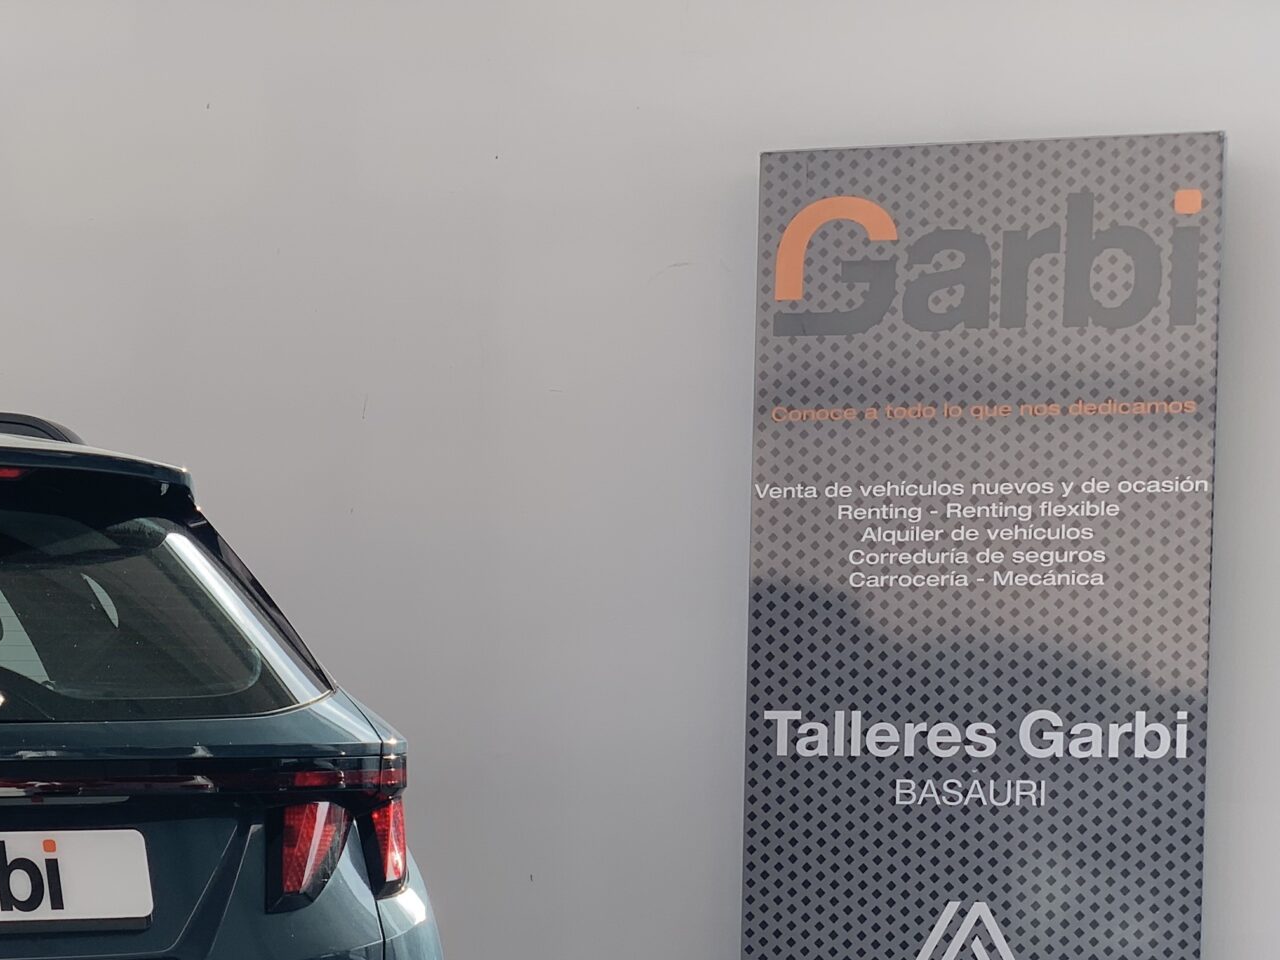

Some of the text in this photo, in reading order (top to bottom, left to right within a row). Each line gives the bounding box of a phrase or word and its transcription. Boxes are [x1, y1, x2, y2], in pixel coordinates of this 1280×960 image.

[773, 188, 1202, 337] Garbi
[771, 399, 1198, 422] Conoce a todo lo que nos dedicamos
[755, 476, 1208, 498] Venta de vehículos nuevos y de ocasión
[837, 504, 922, 522] Renting
[946, 502, 1032, 521] Renting
[1039, 501, 1120, 517] flexible
[860, 524, 1094, 545] Alquiler de vehículos
[848, 548, 1106, 567] Correduría de seguros
[849, 571, 969, 588] Carrocería
[993, 570, 1104, 587] Mecánica
[764, 709, 1188, 759] Talleres Garbi
[895, 778, 1046, 807] BASAURI
